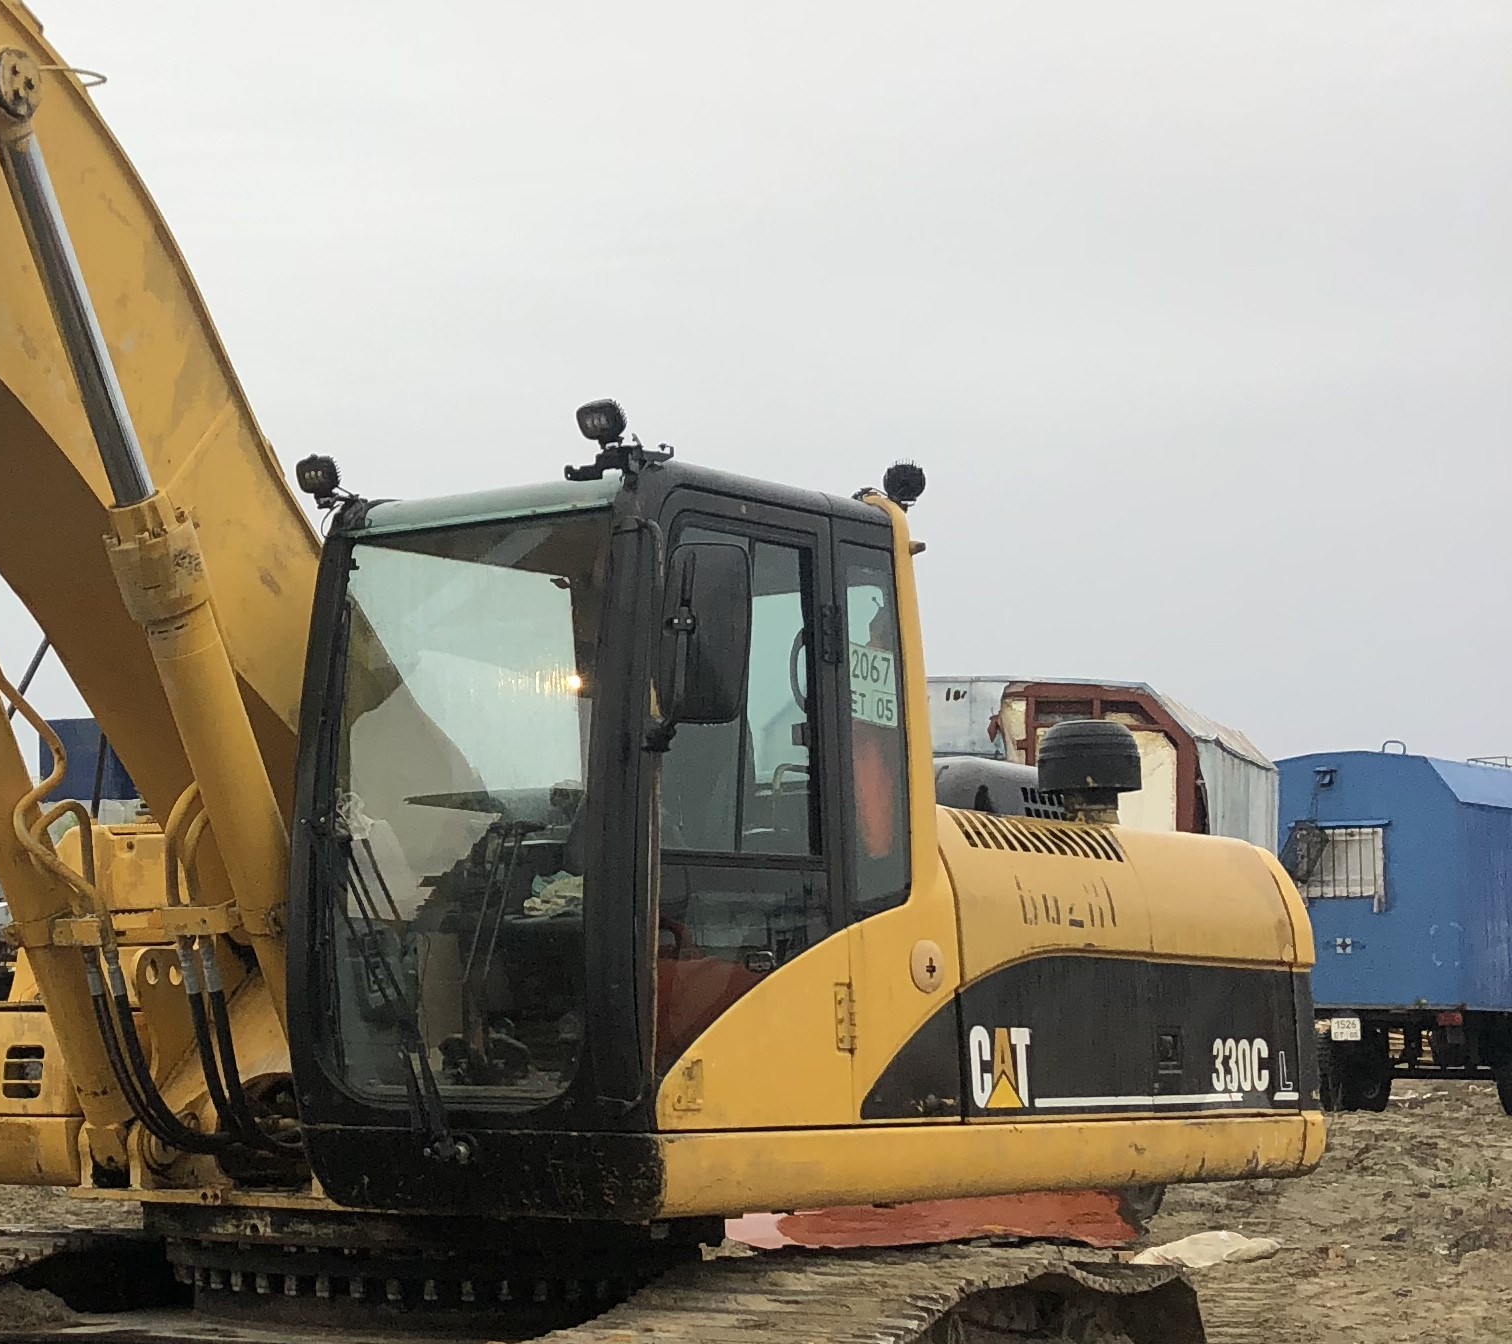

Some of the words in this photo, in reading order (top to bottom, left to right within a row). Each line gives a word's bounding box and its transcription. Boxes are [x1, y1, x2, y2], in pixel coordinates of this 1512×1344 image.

[851, 649, 891, 686] 2067
[876, 697, 893, 722] 05
[969, 1025, 1031, 1109] CAT
[1212, 1038, 1269, 1091] 330C
[1279, 1051, 1293, 1090] L
